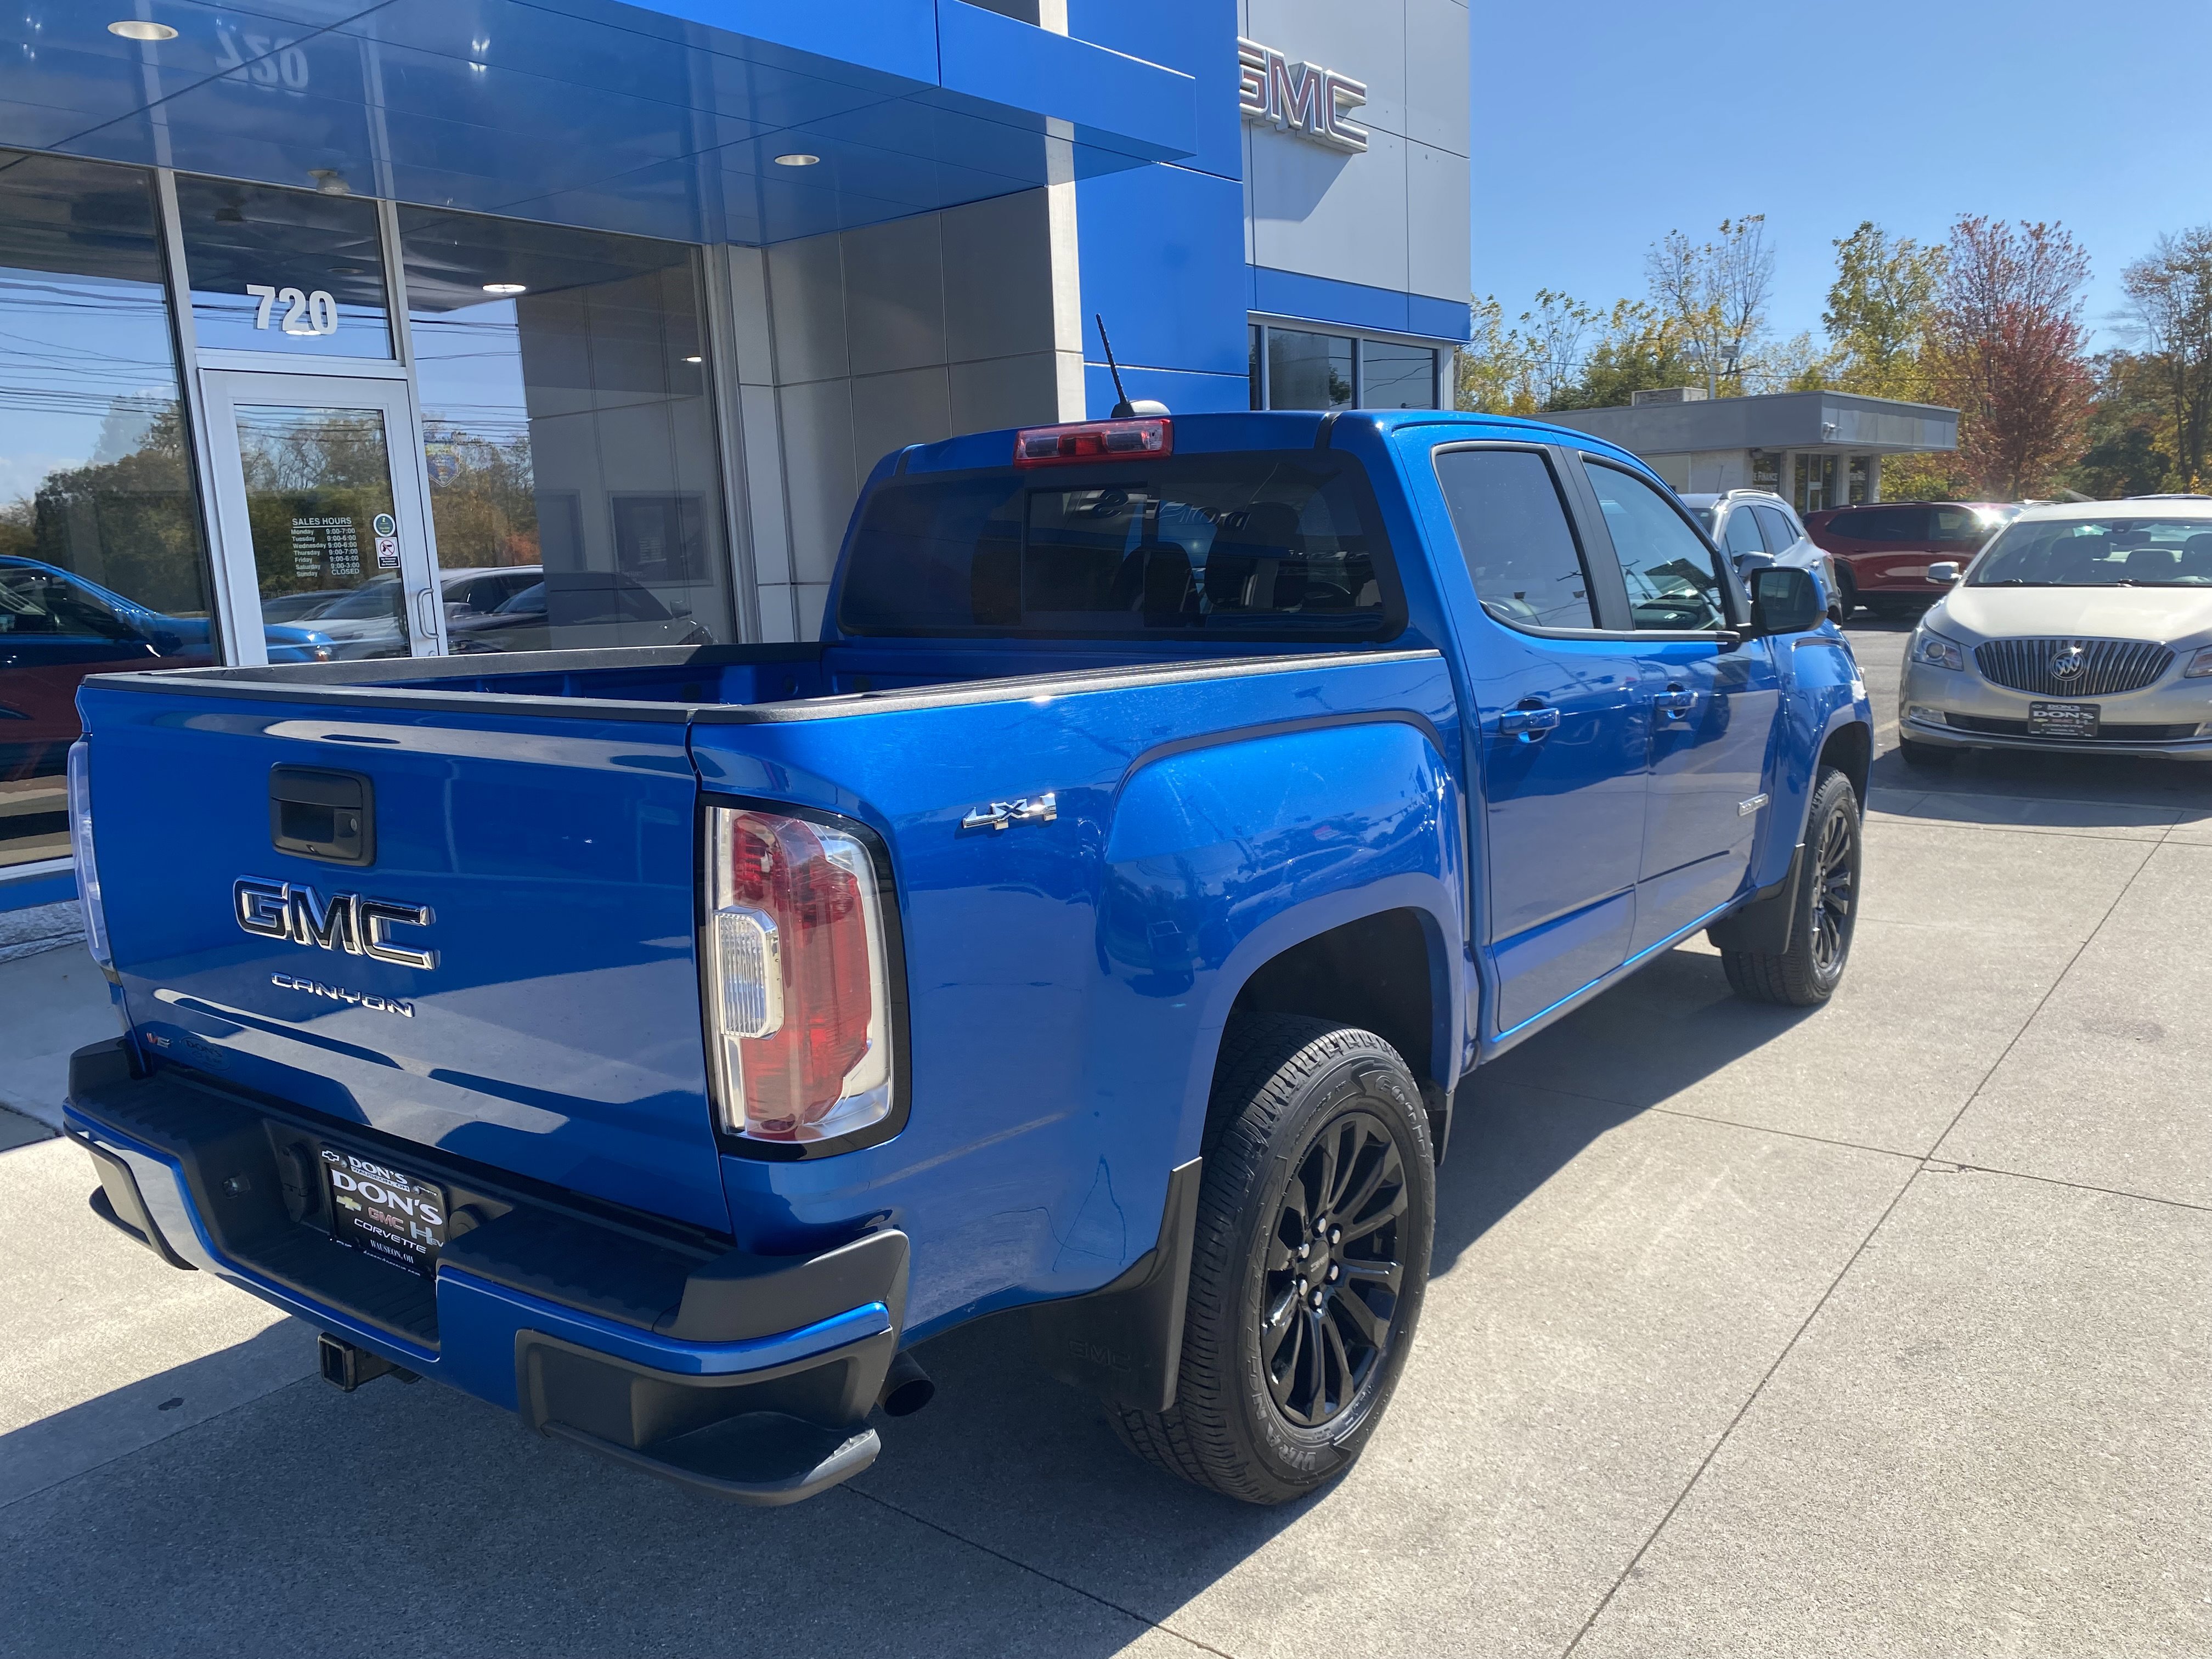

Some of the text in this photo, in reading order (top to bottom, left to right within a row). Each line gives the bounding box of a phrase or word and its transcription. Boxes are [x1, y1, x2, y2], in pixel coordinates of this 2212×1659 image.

[1237, 36, 1369, 153] GMC
[247, 284, 338, 335] 720
[2034, 711, 2095, 719] DON'S
[233, 874, 440, 970] GMC
[271, 971, 415, 1018] CANYON
[347, 1155, 408, 1184] DON'S
[331, 1169, 443, 1225] DON'S
[354, 1218, 427, 1254] CORVETTE
[368, 1206, 404, 1232] GMC
[370, 1239, 403, 1260] WAUSEON,
[403, 1253, 414, 1263] OH
